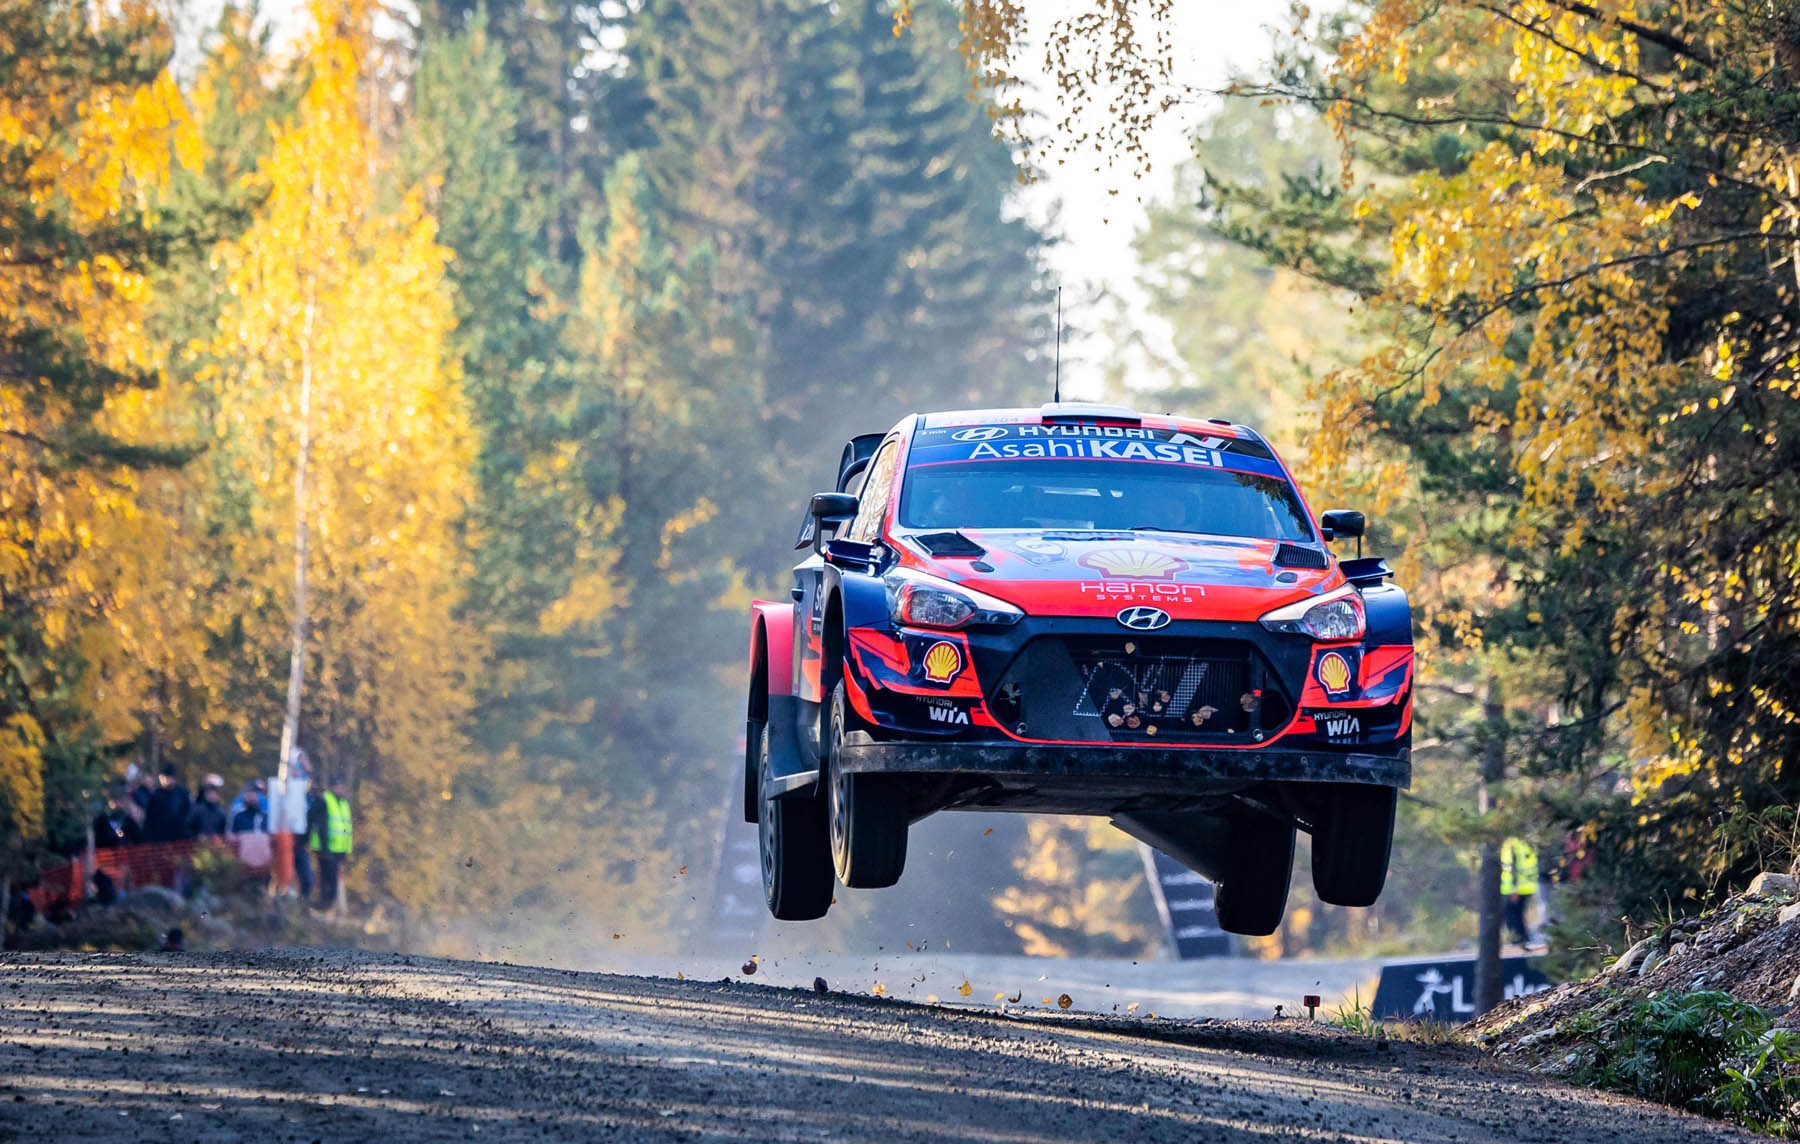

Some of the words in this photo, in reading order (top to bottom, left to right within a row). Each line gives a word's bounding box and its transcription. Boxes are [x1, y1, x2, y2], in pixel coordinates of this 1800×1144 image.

[1018, 425, 1155, 440] HYUNDAI
[1096, 594, 1193, 603] SYSTEMS
[915, 695, 953, 708] HYUNDAI
[1314, 710, 1347, 721] HYUNDAI
